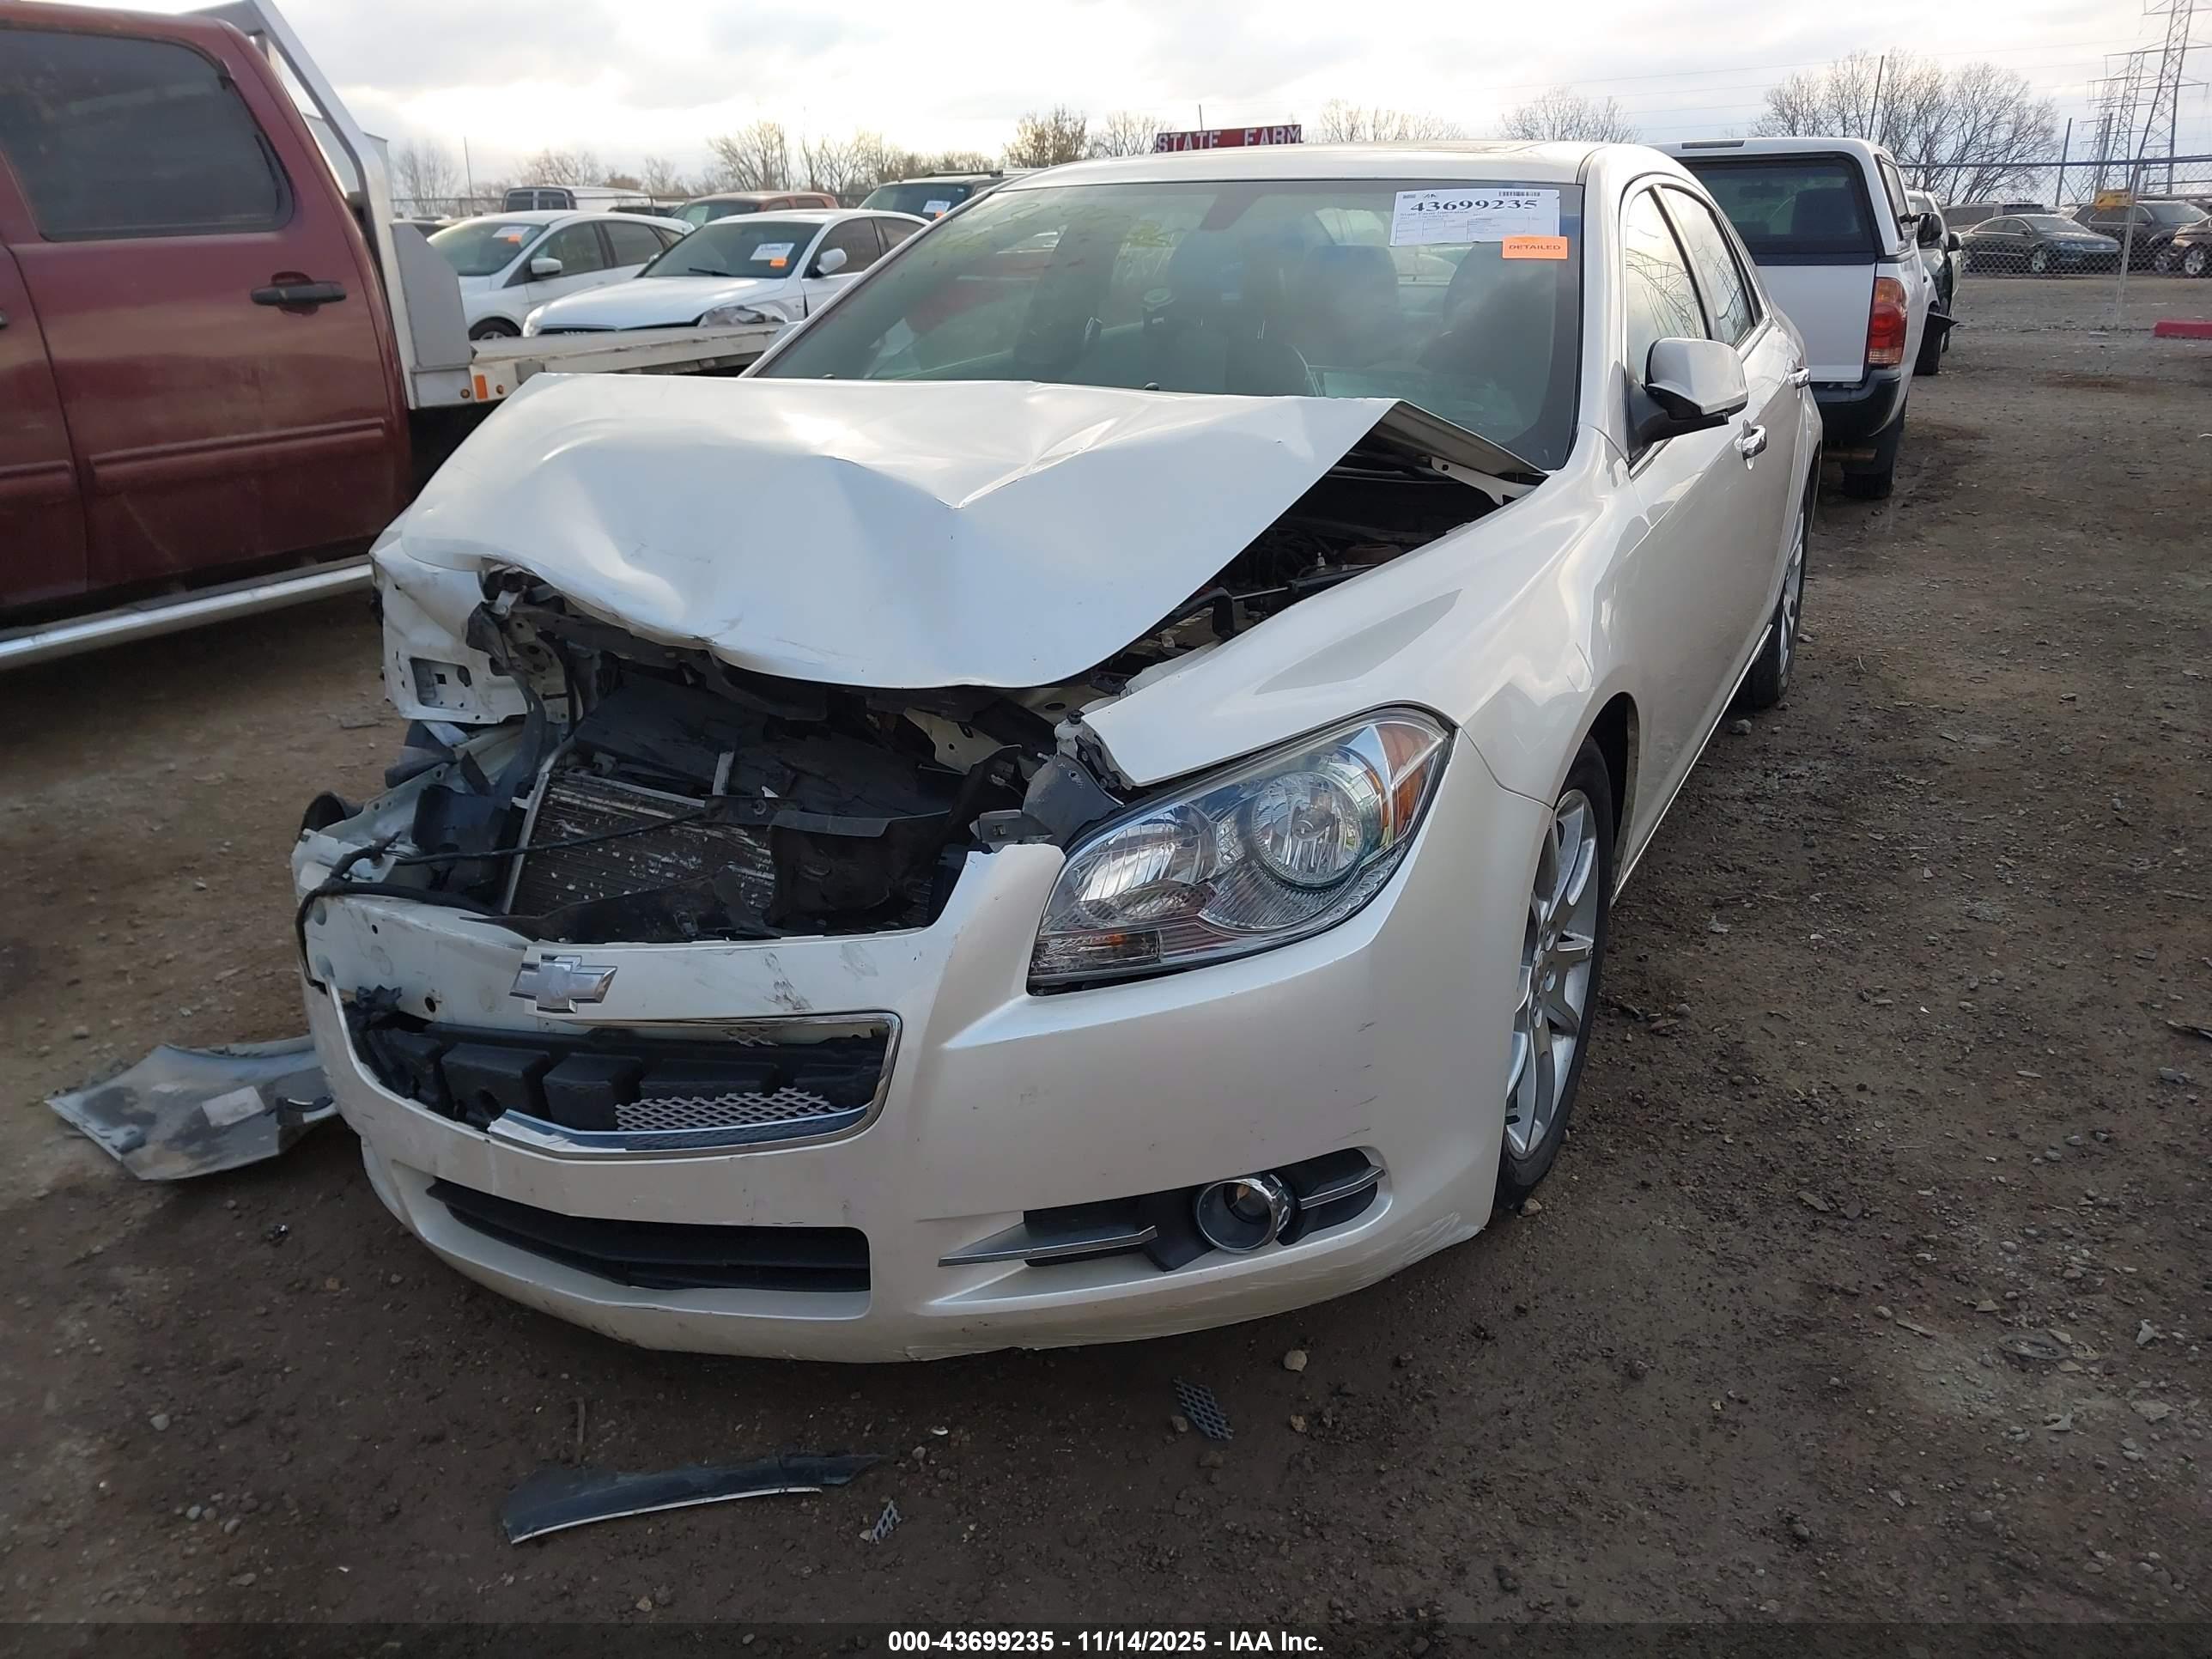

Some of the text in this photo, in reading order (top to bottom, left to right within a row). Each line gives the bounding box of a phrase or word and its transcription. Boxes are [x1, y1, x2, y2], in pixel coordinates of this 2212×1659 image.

[1157, 126, 1301, 153] STATE FARM
[1410, 199, 1538, 211] 43699235
